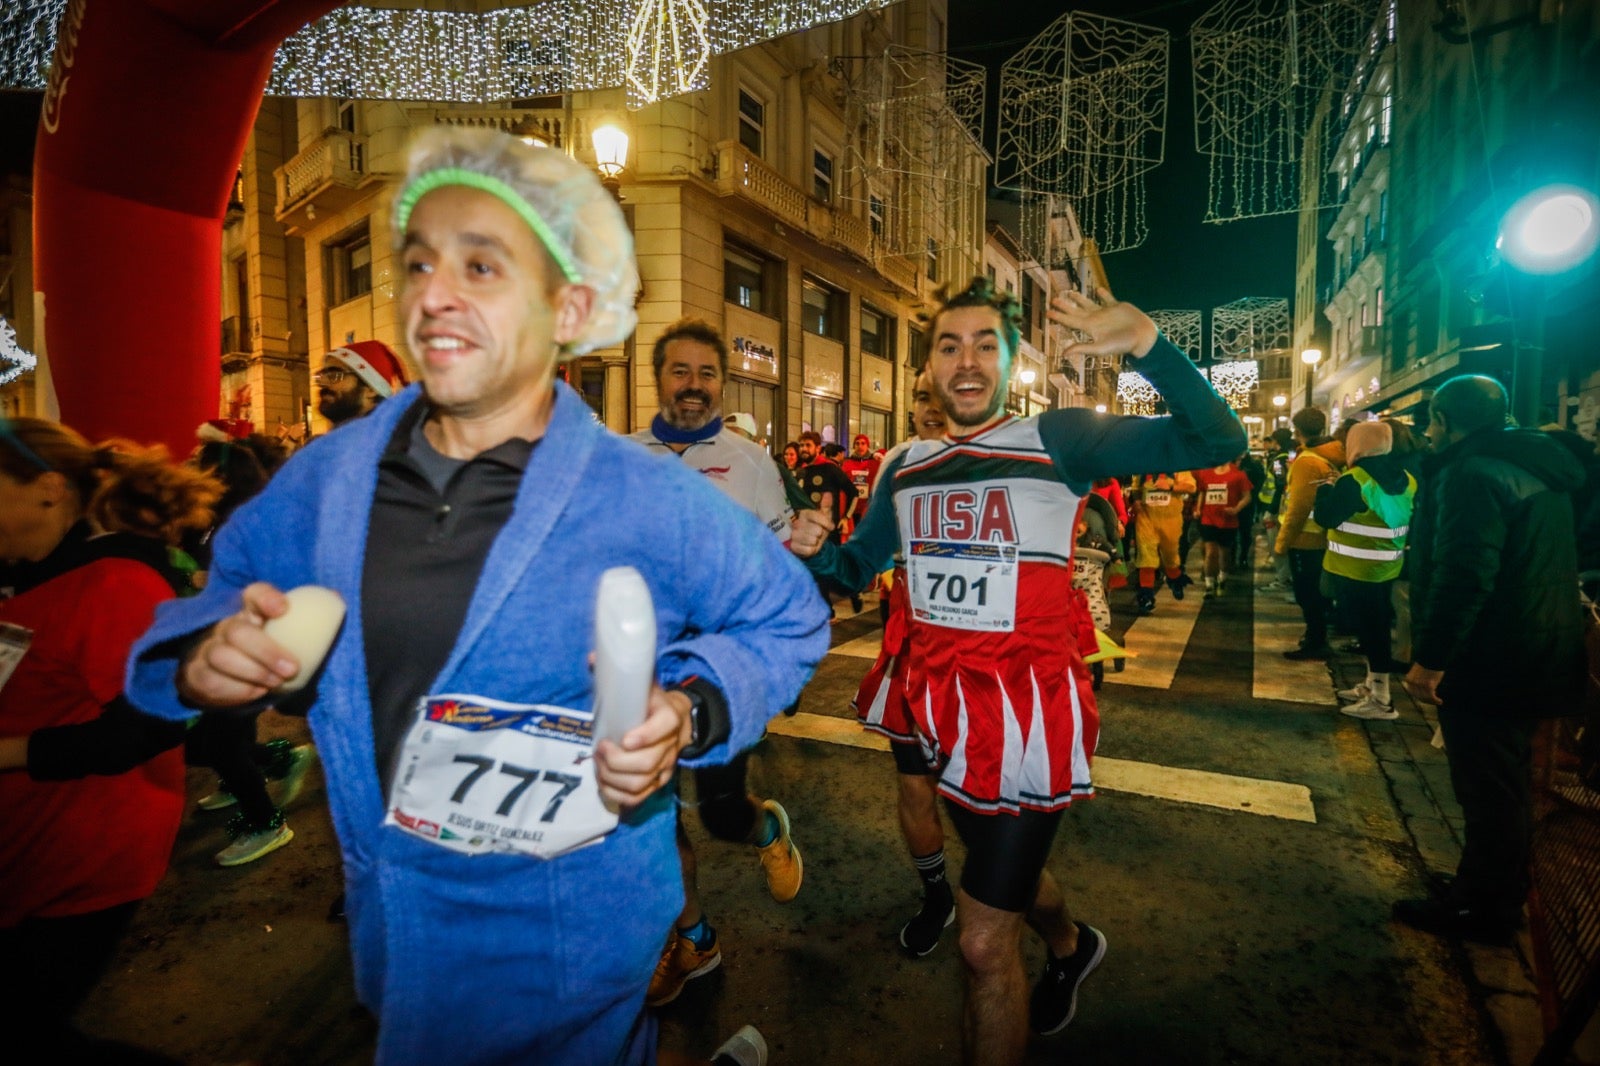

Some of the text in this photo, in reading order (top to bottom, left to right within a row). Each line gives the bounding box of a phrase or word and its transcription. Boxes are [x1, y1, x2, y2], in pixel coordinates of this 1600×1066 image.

[910, 486, 1020, 545] USA
[926, 572, 988, 607] 701
[449, 754, 583, 823] 777
[448, 812, 474, 829] JESUS
[473, 819, 500, 836] ORTIZ
[500, 826, 545, 842] GONZALEZ
